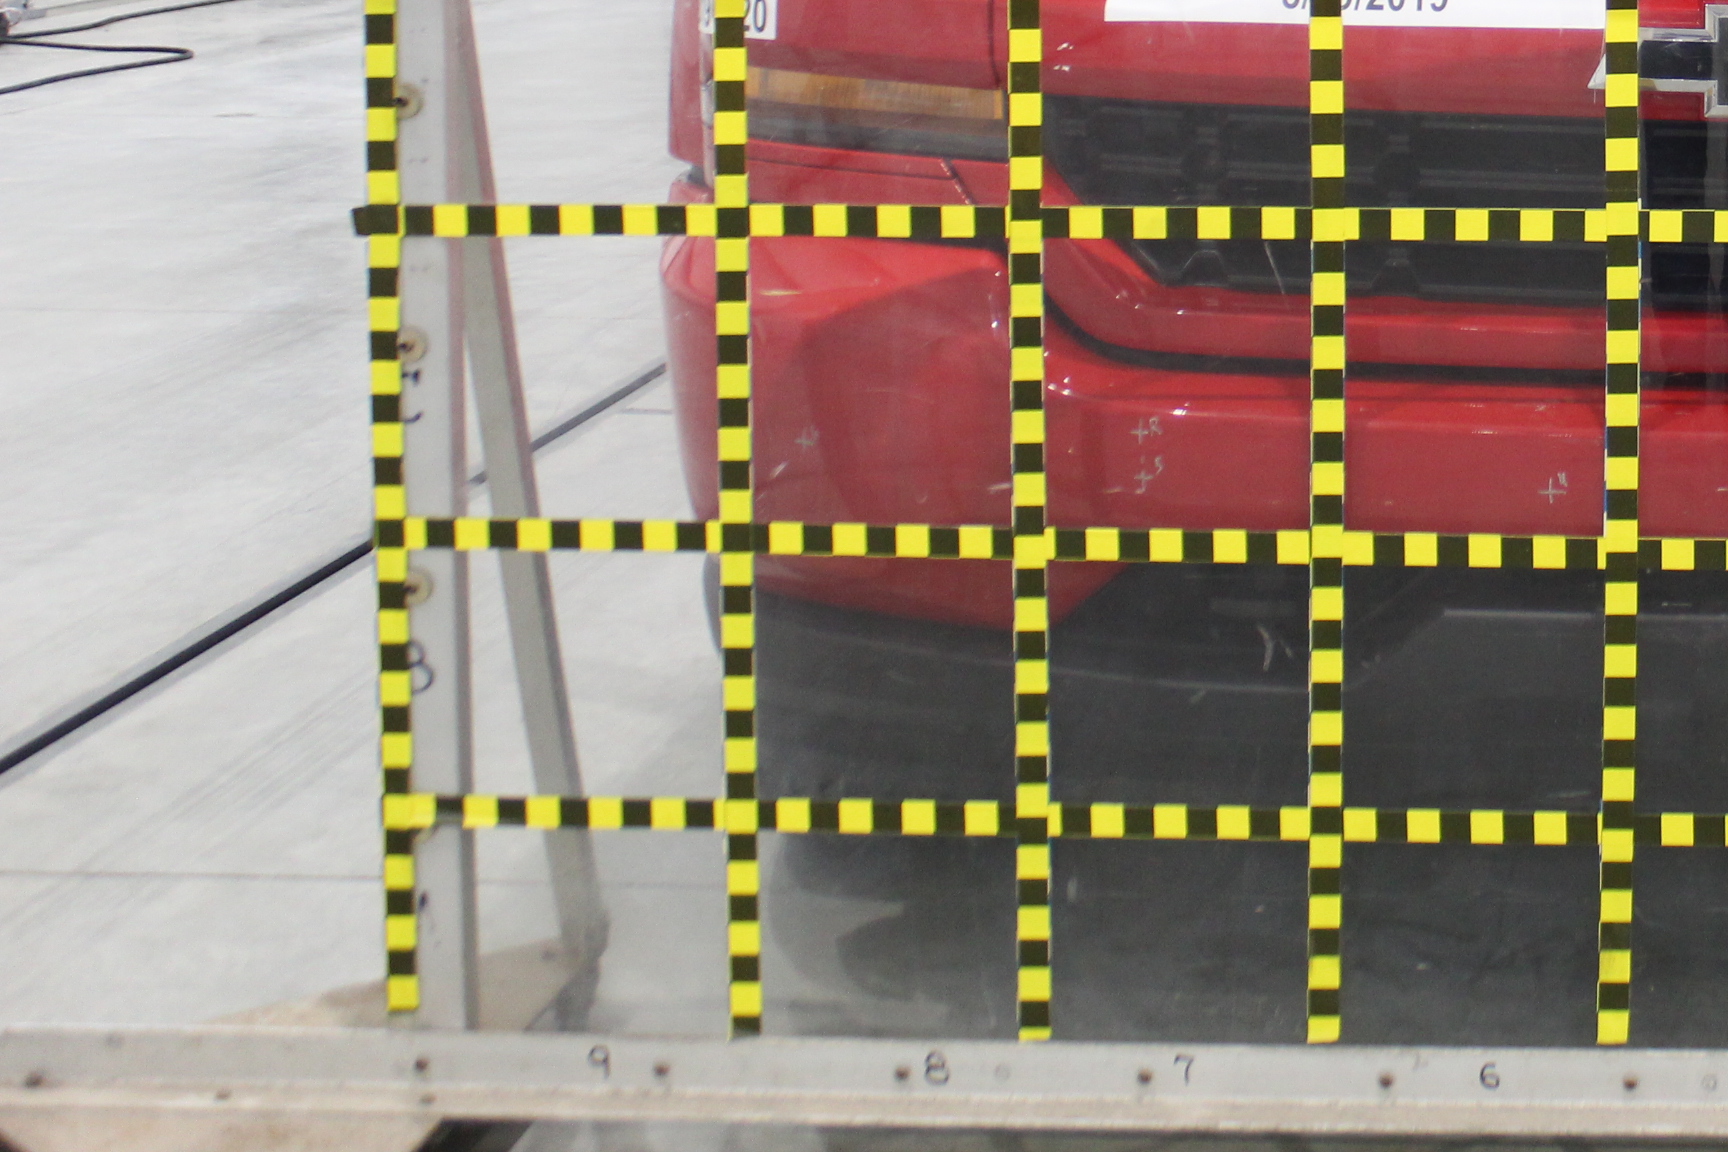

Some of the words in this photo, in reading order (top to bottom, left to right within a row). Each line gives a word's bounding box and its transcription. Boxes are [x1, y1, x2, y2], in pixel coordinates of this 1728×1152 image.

[924, 1050, 949, 1084] 8
[1173, 1054, 1194, 1084] 7
[1479, 1062, 1500, 1090] 6
